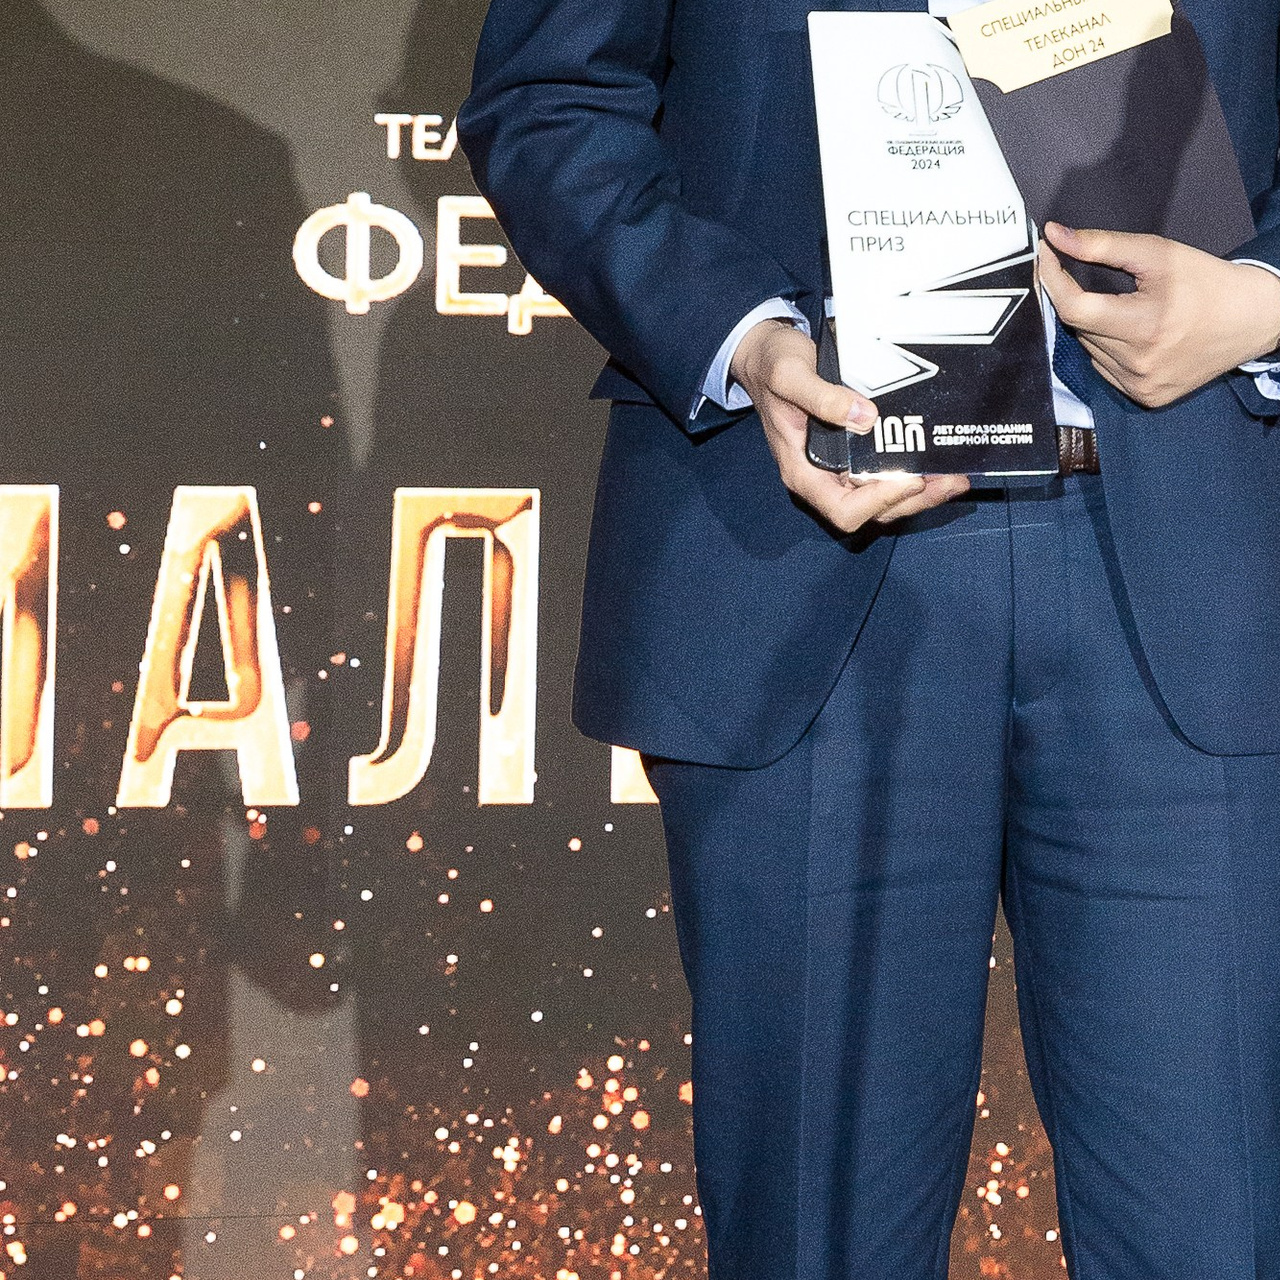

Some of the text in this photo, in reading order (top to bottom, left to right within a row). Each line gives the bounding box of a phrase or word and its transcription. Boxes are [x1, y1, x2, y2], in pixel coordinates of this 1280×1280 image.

[1023, 12, 1112, 52] ТЕЛЕКАНАЛ
[1053, 36, 1106, 69] ДОН 24
[887, 145, 965, 156] ФЕДЕРАЦИЯ
[911, 159, 941, 170] 2024
[847, 206, 1018, 228] СПЕЦИАЛЬНЫЙ
[849, 236, 905, 252] ПРИЗ
[932, 423, 1033, 436] ЛЕТ ОБРАЗОВАНИЯ
[932, 433, 1033, 446] СЕВЕРНОЙ ОСЕТИИ
